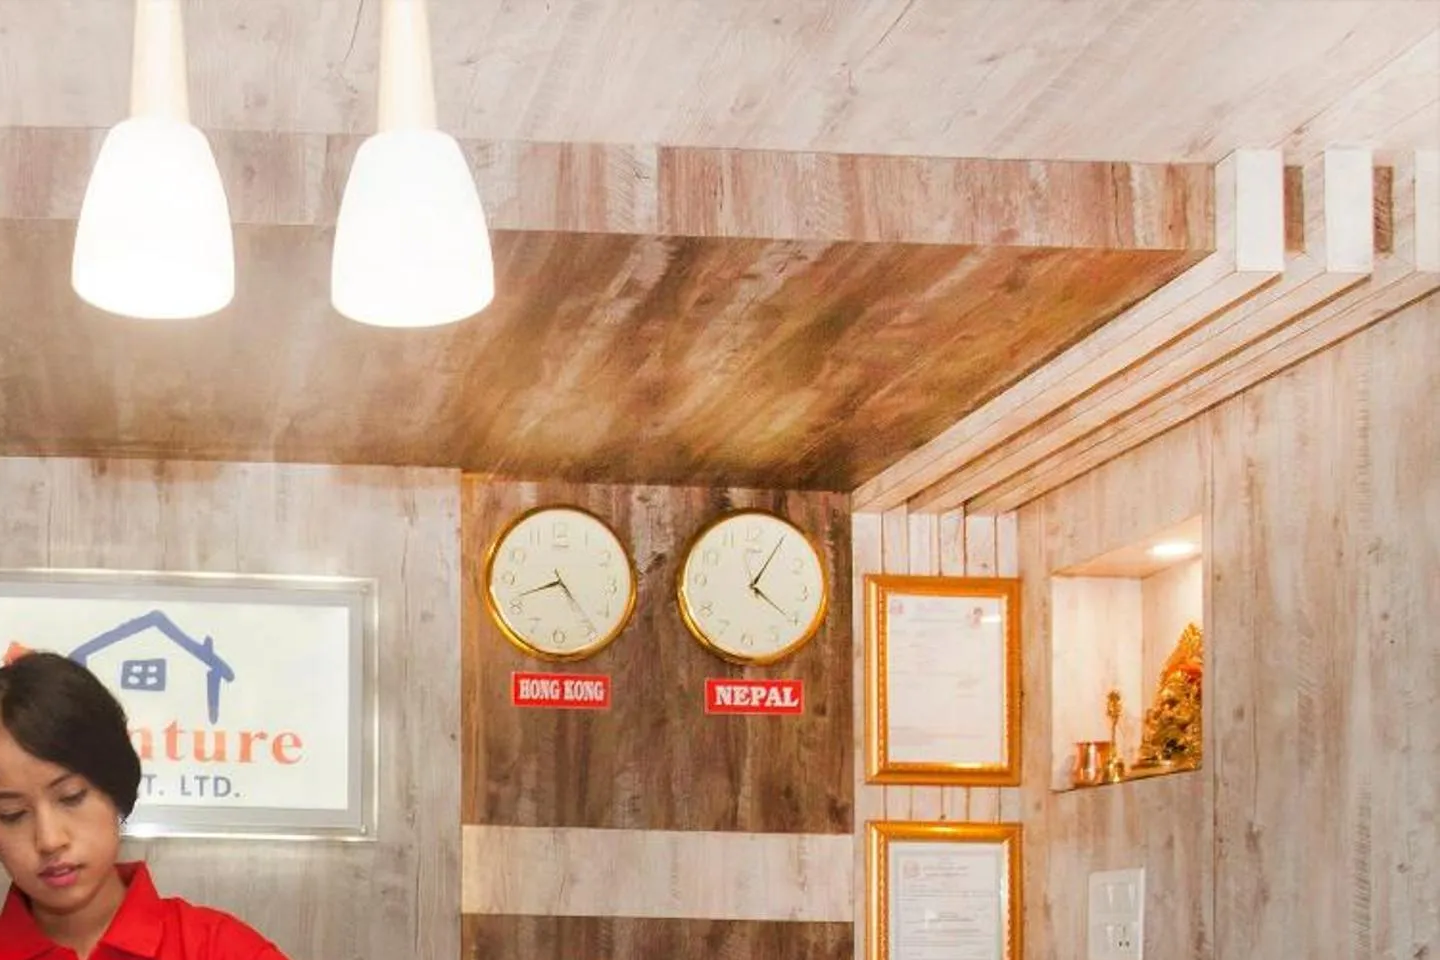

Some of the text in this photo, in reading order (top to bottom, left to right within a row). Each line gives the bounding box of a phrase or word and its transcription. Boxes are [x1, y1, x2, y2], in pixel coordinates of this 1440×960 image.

[519, 679, 605, 702] HONG KONG
[714, 685, 799, 708] NEPAL
[180, 774, 241, 799] LTD.
